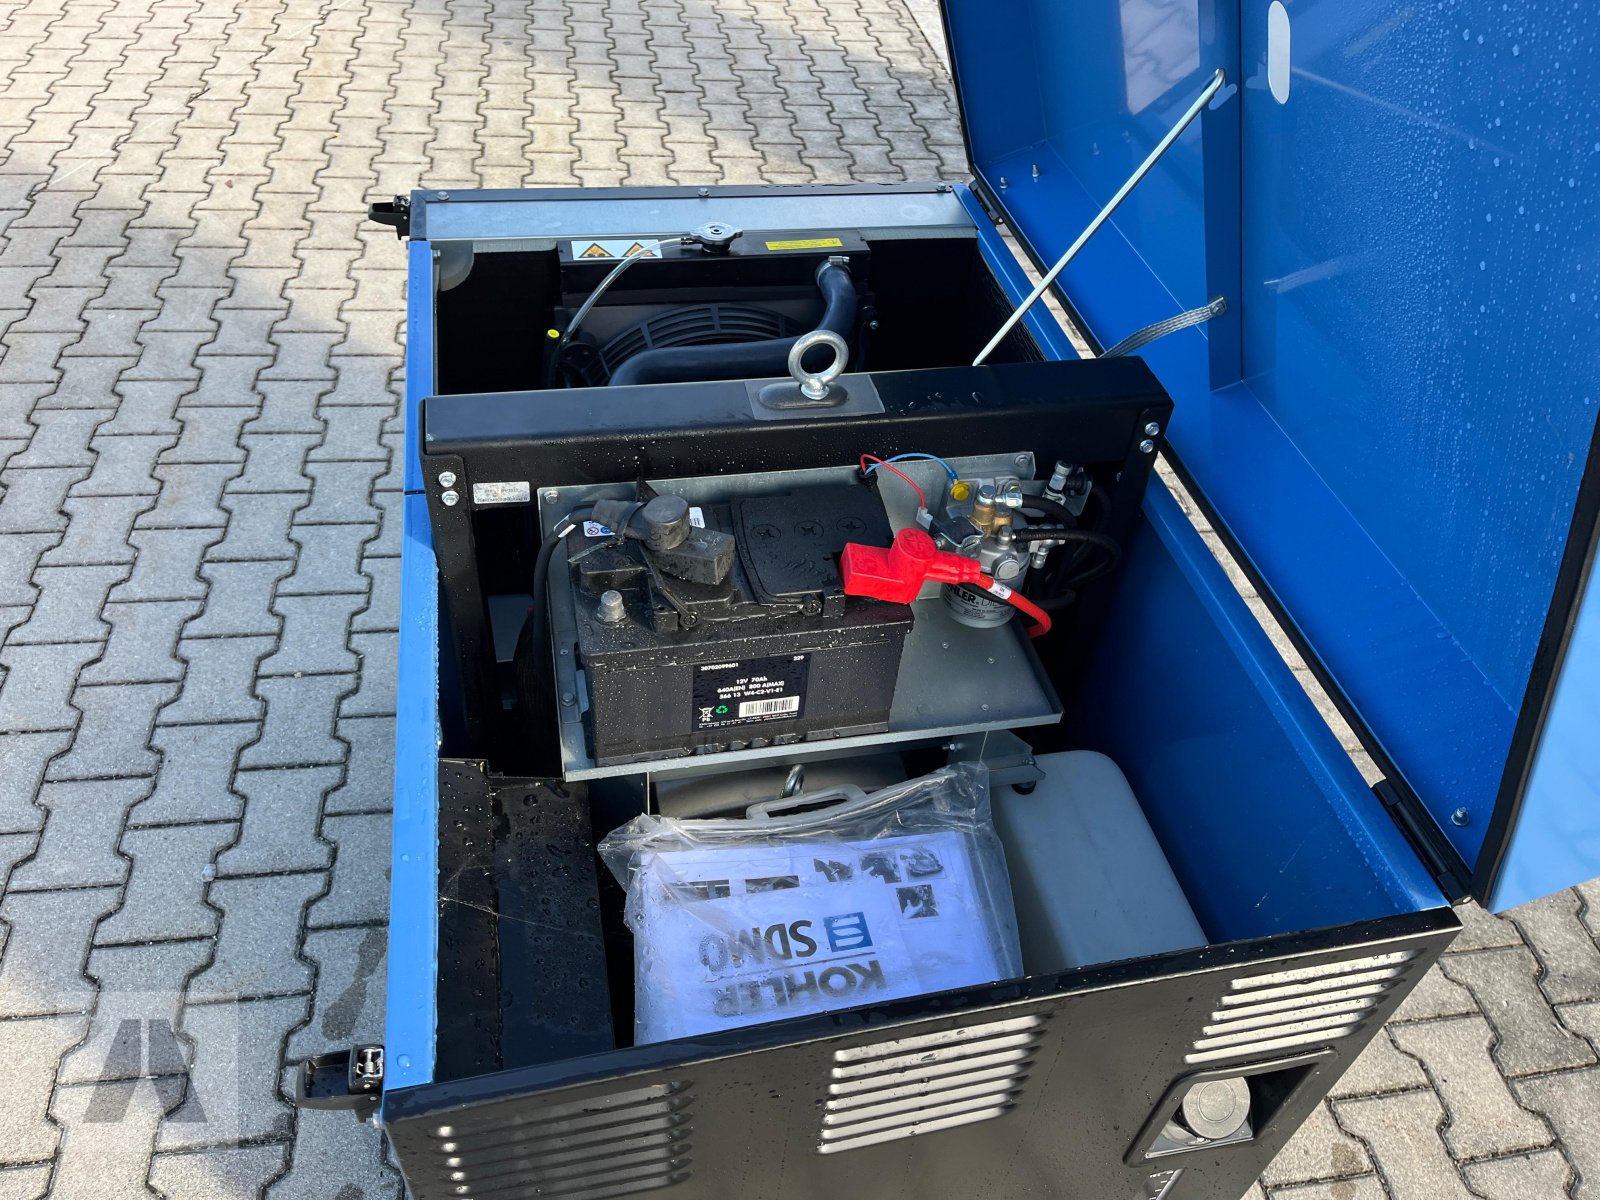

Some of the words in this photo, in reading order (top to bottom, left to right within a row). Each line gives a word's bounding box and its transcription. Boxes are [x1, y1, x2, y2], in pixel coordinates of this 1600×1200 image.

[717, 685, 746, 693] 640A(EN)
[699, 920, 818, 977] SDMO
[712, 960, 888, 1018] KOHLER
